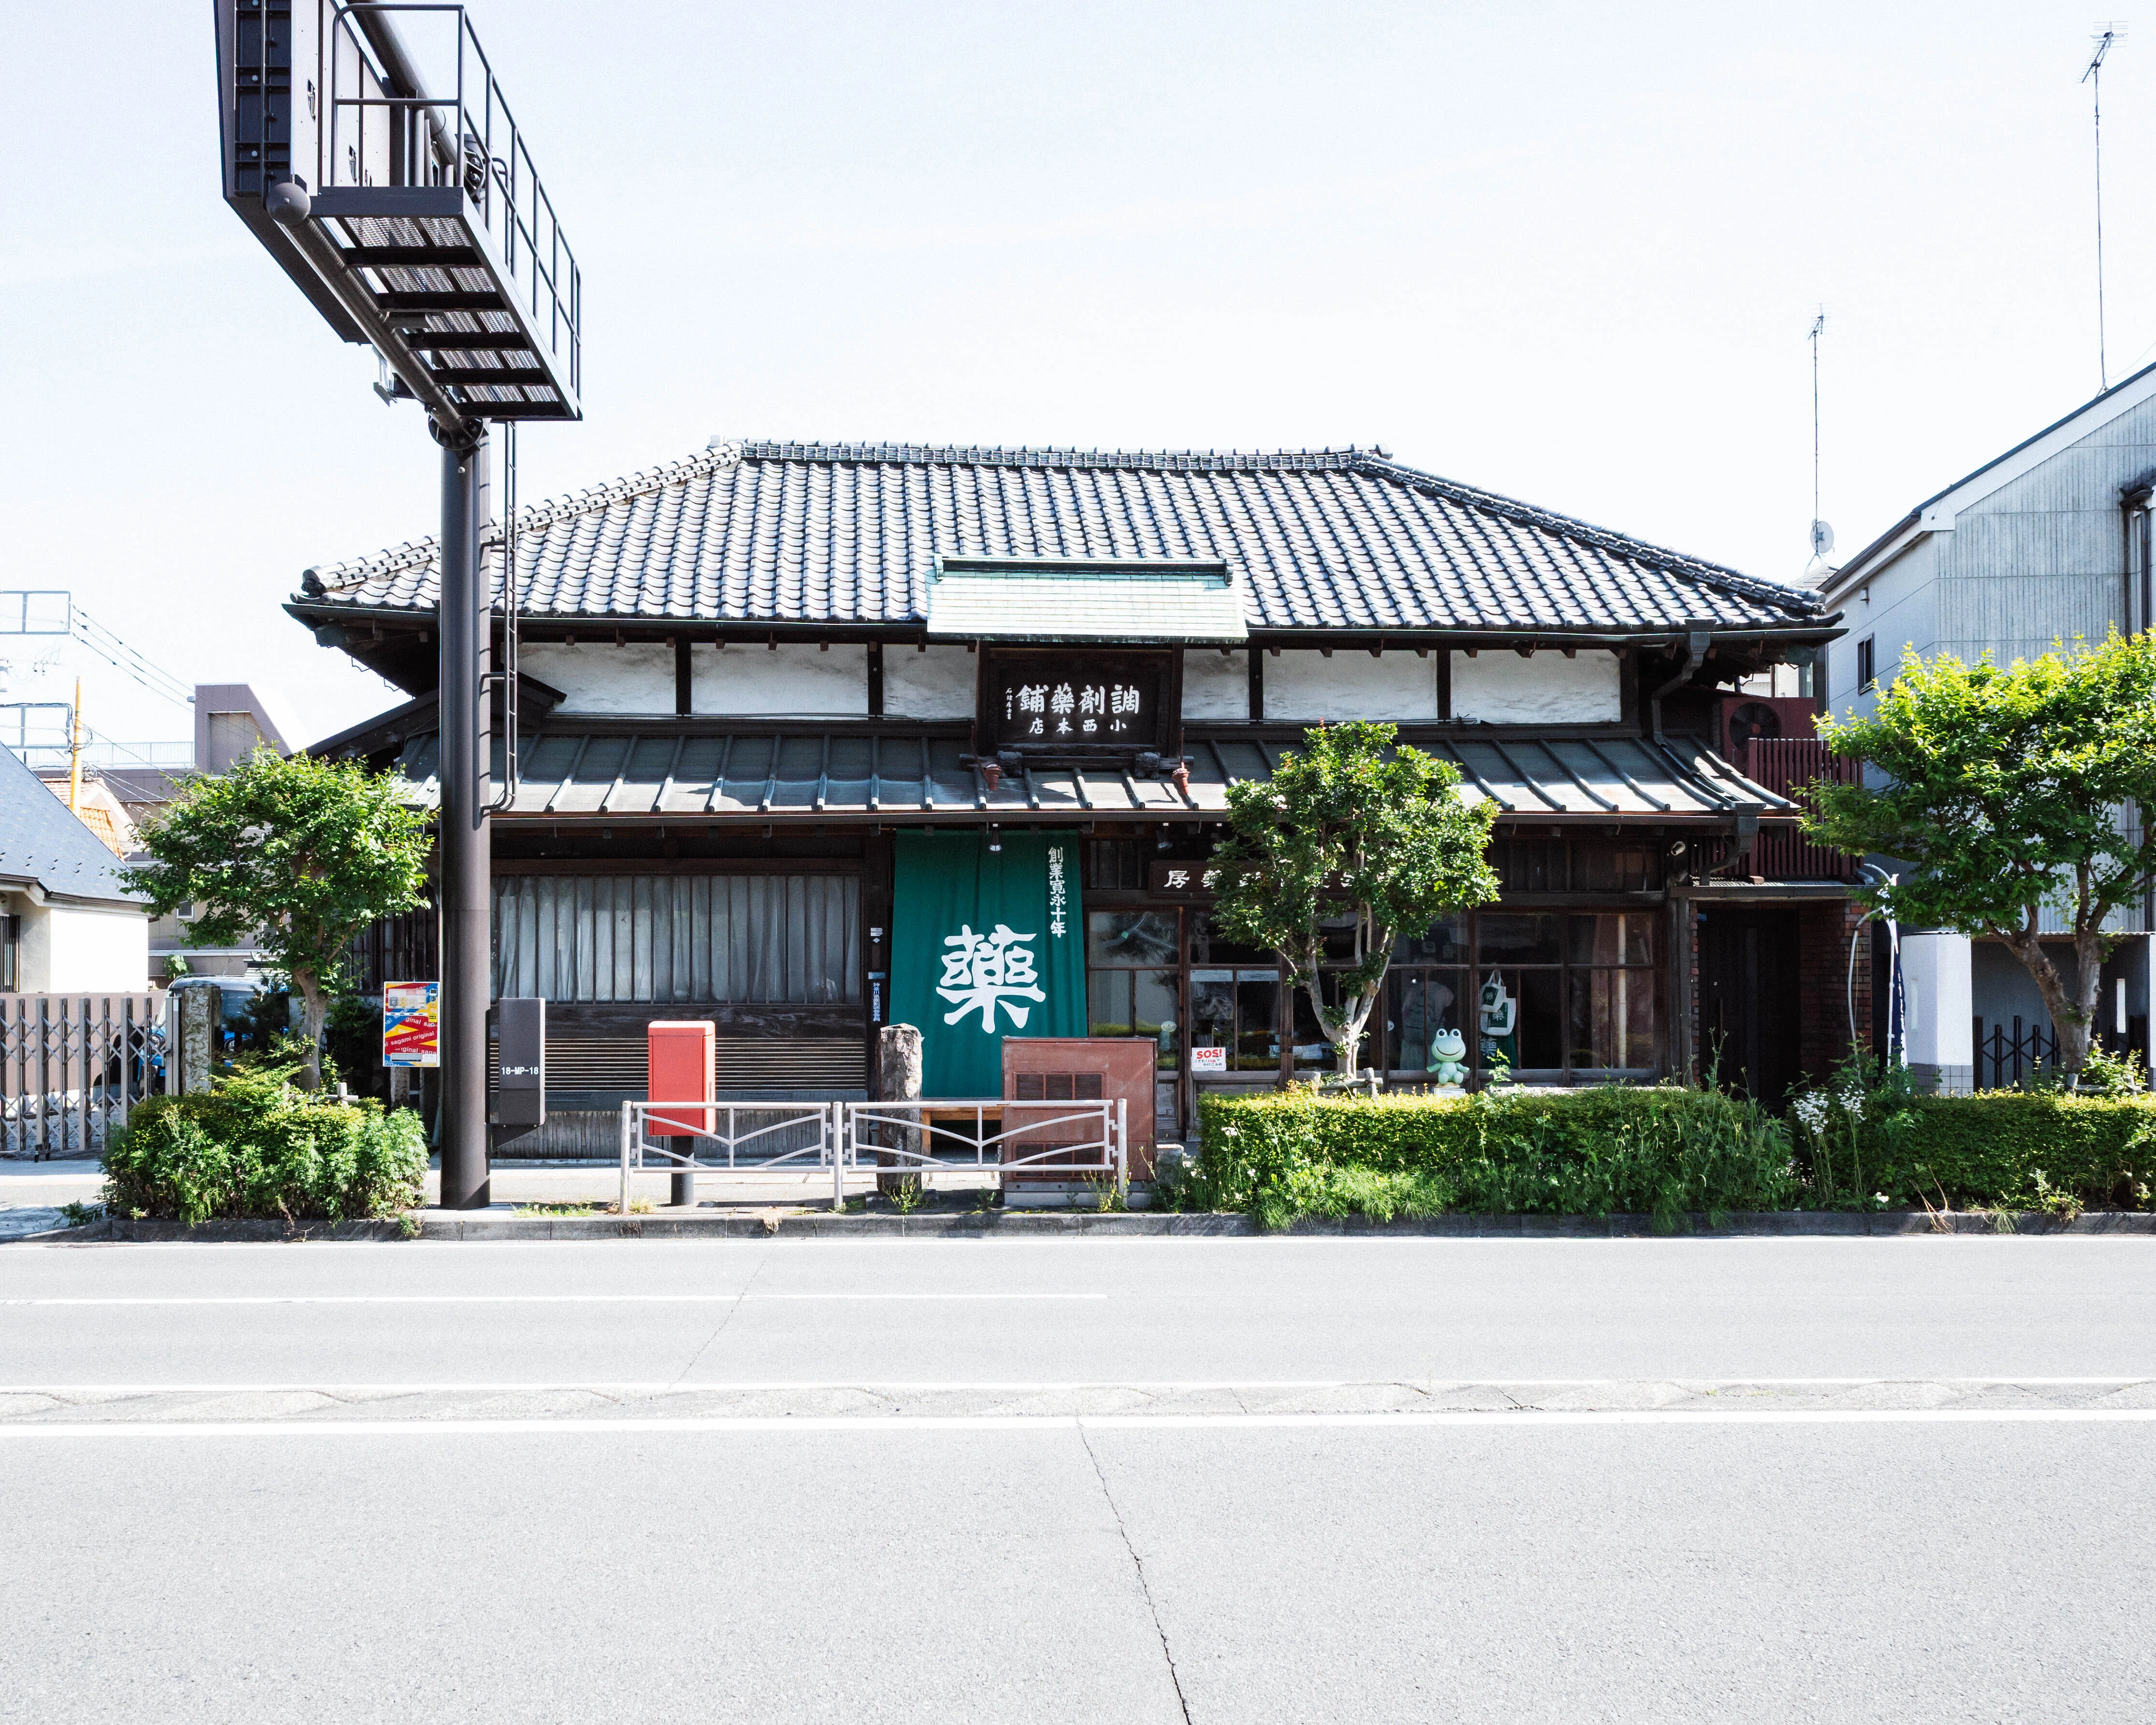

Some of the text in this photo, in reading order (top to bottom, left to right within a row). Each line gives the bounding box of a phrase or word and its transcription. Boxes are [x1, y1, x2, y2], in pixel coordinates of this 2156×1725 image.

[1029, 717, 1127, 735] 小西本店
[390, 1036, 412, 1046] sagami
[413, 1031, 435, 1040] original
[1197, 1049, 1222, 1059] SOS!
[501, 1066, 539, 1075] 18-MP-18
